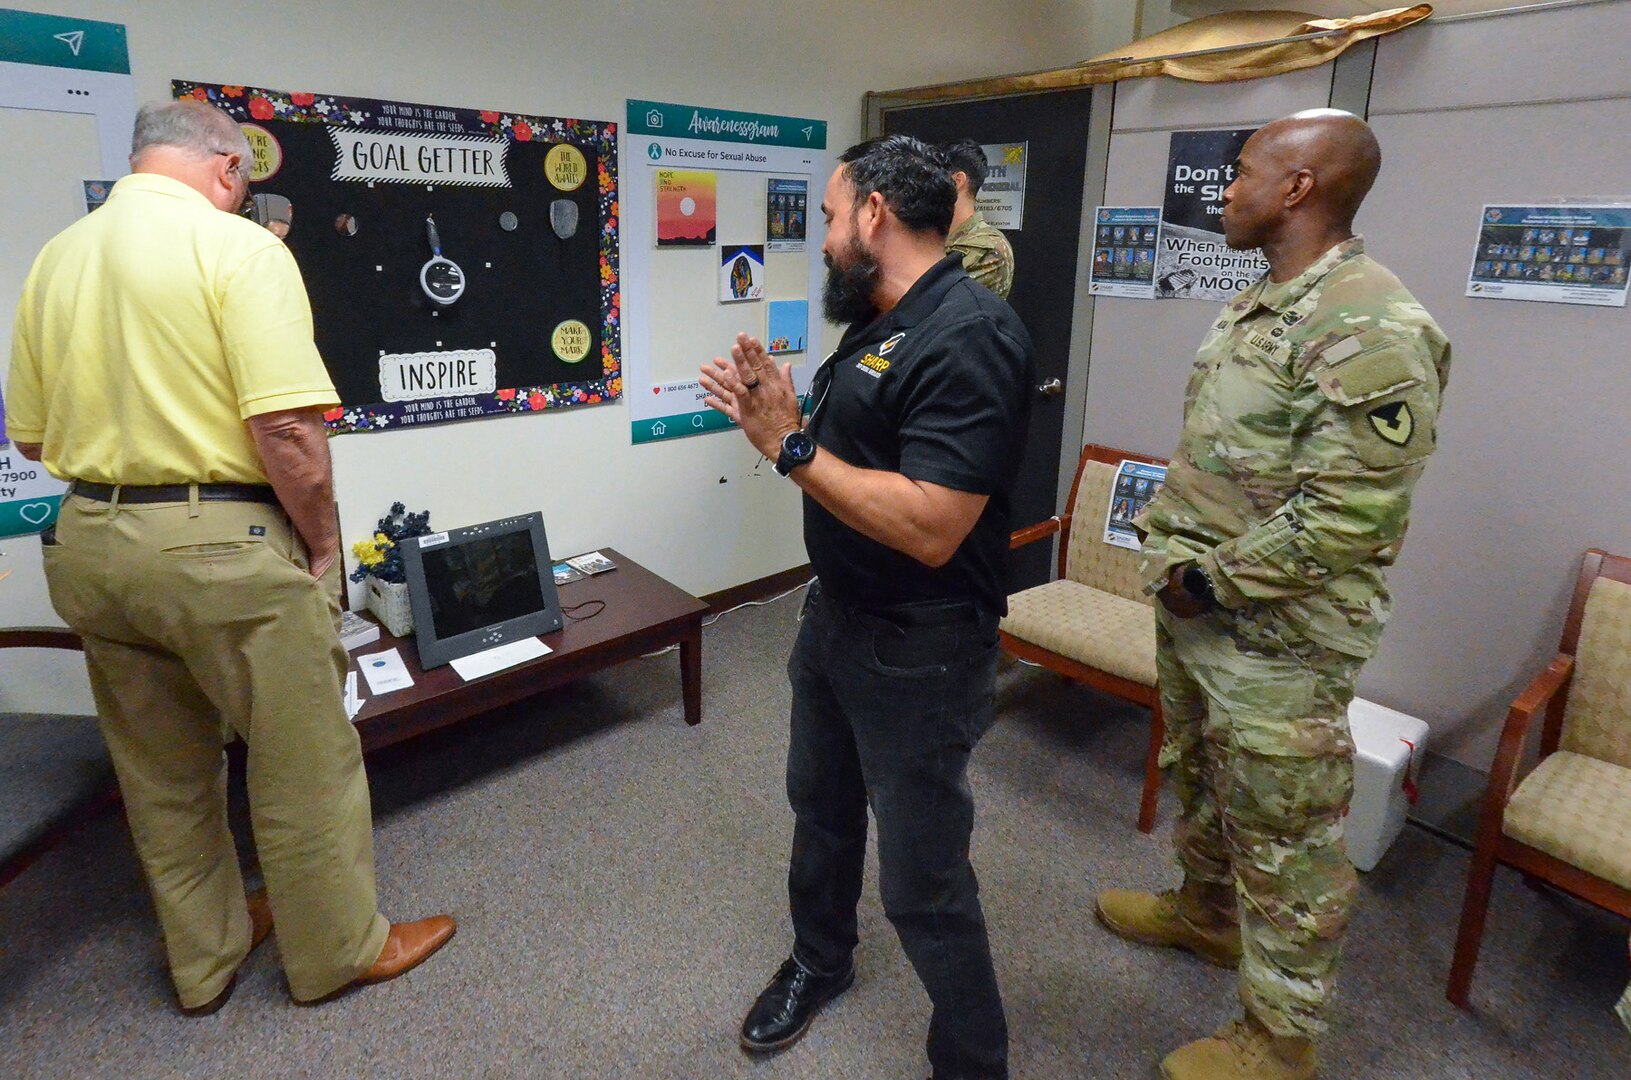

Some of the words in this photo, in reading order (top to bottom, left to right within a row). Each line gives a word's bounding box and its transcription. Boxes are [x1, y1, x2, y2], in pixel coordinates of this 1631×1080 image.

[382, 105, 396, 115] YOUR
[399, 106, 412, 116] MIND
[415, 108, 421, 118] IS
[423, 108, 432, 119] THE
[377, 116, 392, 127] YOUR
[395, 117, 422, 130] THOUGHTS
[424, 120, 435, 131] ARE
[437, 121, 446, 132] THE
[688, 110, 780, 140] Awarenessgram
[353, 142, 410, 171] GOAL
[418, 146, 495, 175] GETTER
[665, 148, 677, 157] No
[679, 148, 705, 159] Excuse
[707, 149, 718, 159] for
[720, 151, 744, 161] Sexual
[745, 153, 767, 162] Abuse
[1174, 164, 1234, 181] Don't
[1174, 184, 1194, 193] the
[1166, 238, 1215, 252] When
[1178, 253, 1269, 270] Footprints
[1200, 277, 1254, 291] MOO
[561, 337, 582, 345] YOUR
[861, 353, 890, 371] SHARP
[400, 360, 478, 391] INSPIRE
[405, 403, 419, 413] YOUR
[420, 402, 434, 411] MIND
[436, 401, 442, 409] IS
[444, 400, 453, 409] THE
[400, 414, 414, 424] YOUR
[416, 412, 443, 423] THOUGHTS
[445, 410, 455, 419] ARE
[458, 408, 467, 417] THE
